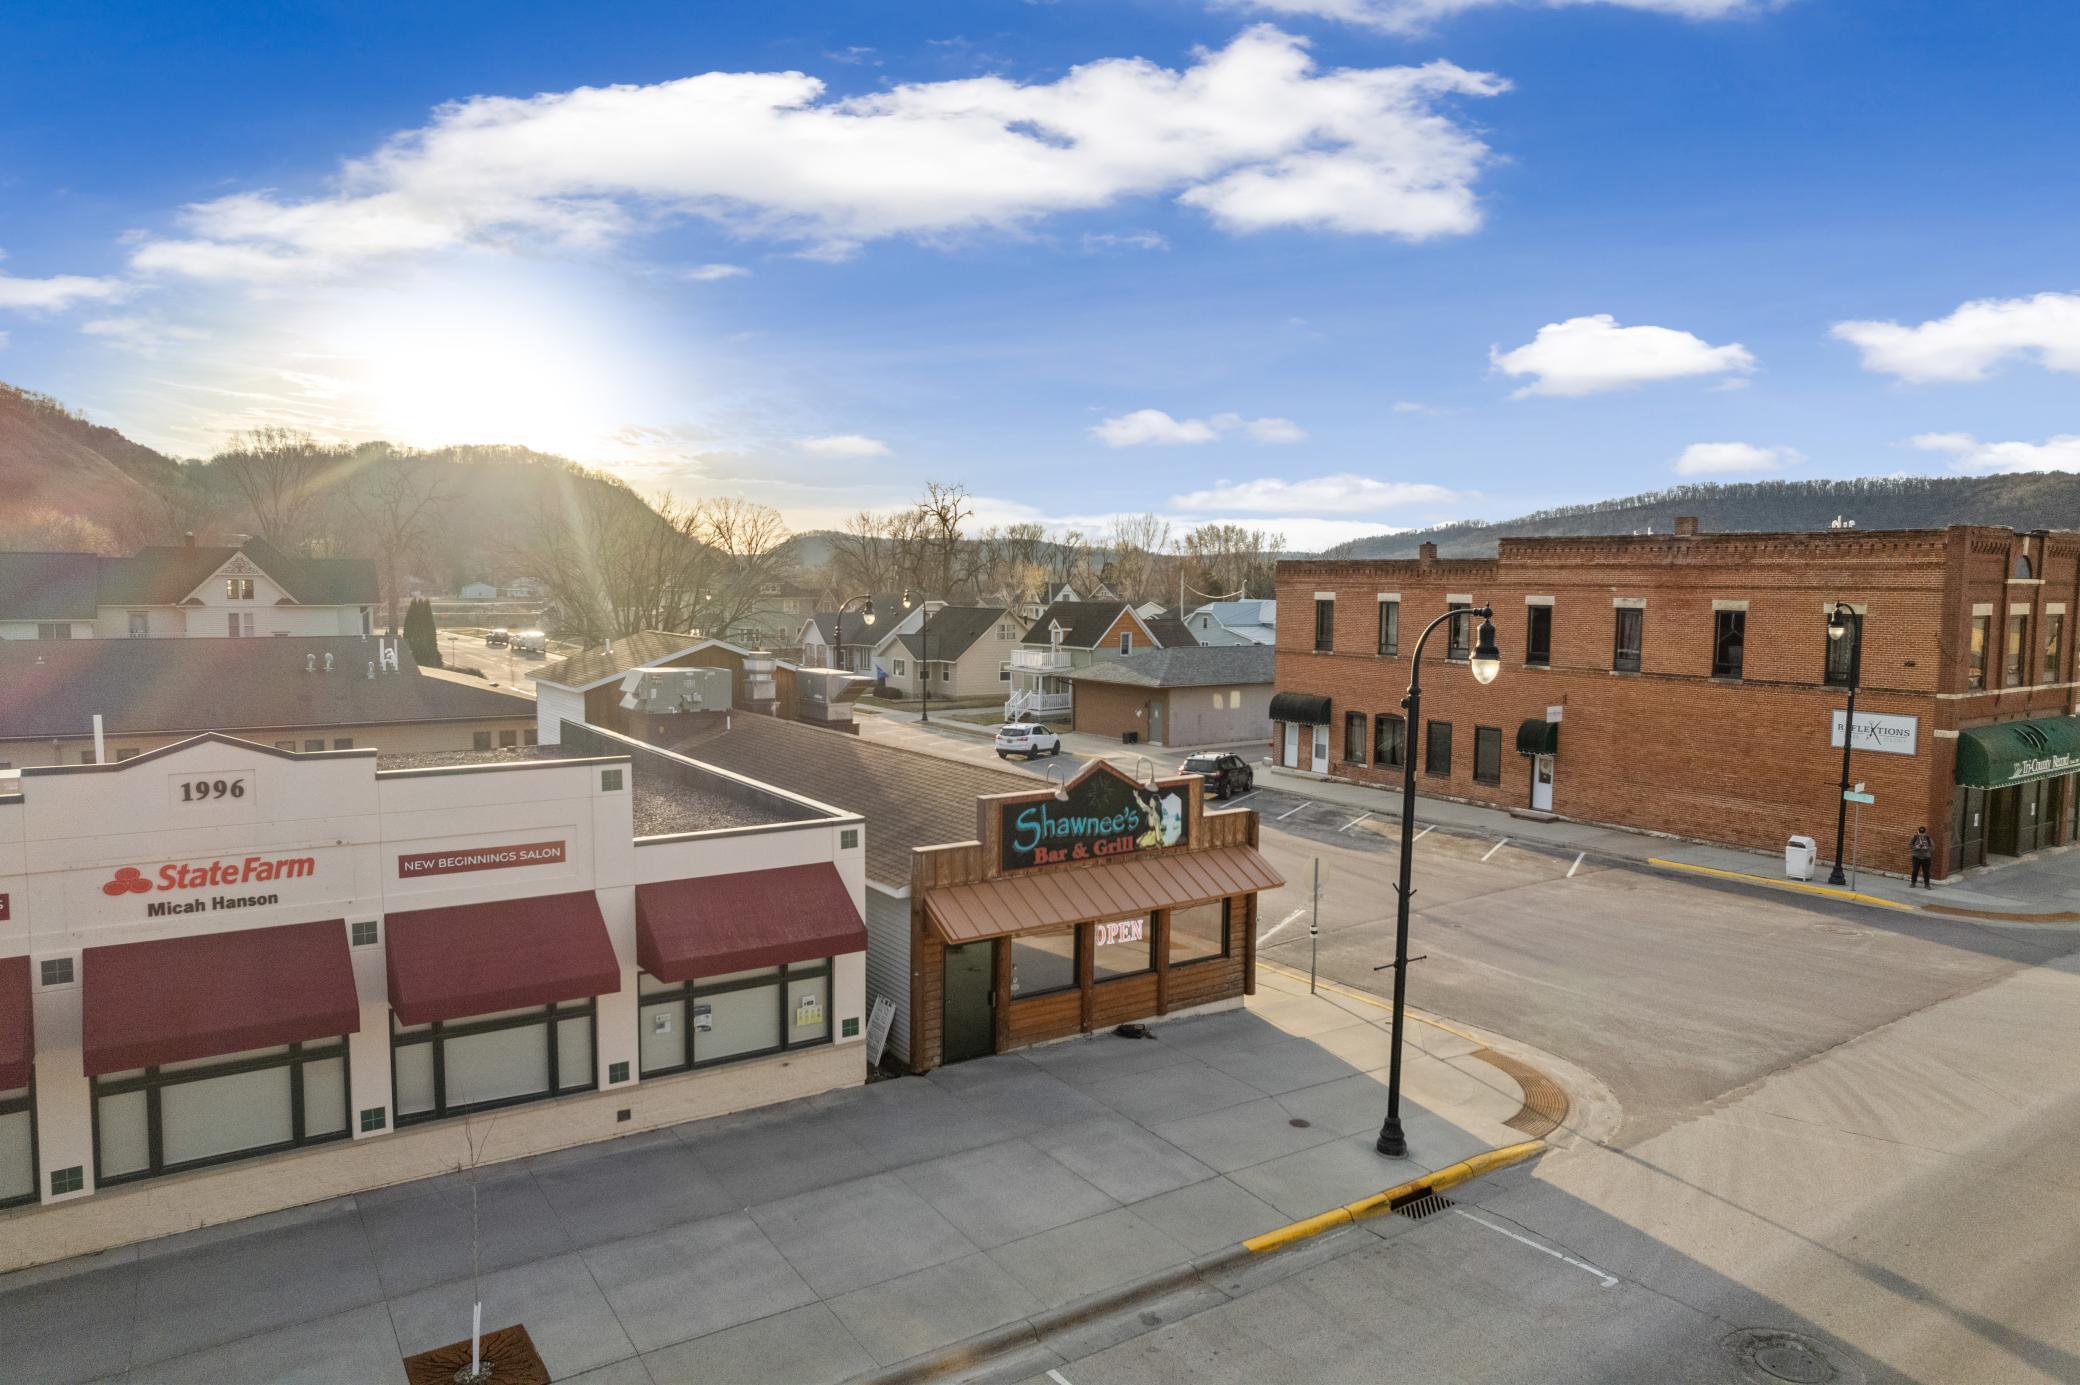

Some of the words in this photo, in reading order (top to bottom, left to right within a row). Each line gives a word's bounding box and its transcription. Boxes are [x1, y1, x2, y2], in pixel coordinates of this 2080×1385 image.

[1837, 720, 1911, 744] RFLEXTIONS
[181, 779, 245, 802] 1996
[1013, 803, 1139, 851] Shawnee's
[404, 859, 435, 871] NEW
[439, 851, 517, 868] BEGINNINGS
[520, 848, 561, 860] SALON
[1034, 846, 1067, 864] Bar
[1072, 842, 1089, 859] &
[1093, 835, 1134, 855] Grill
[148, 898, 206, 917] Micah
[212, 893, 279, 910] Hanson
[1096, 920, 1143, 946] OPEN
